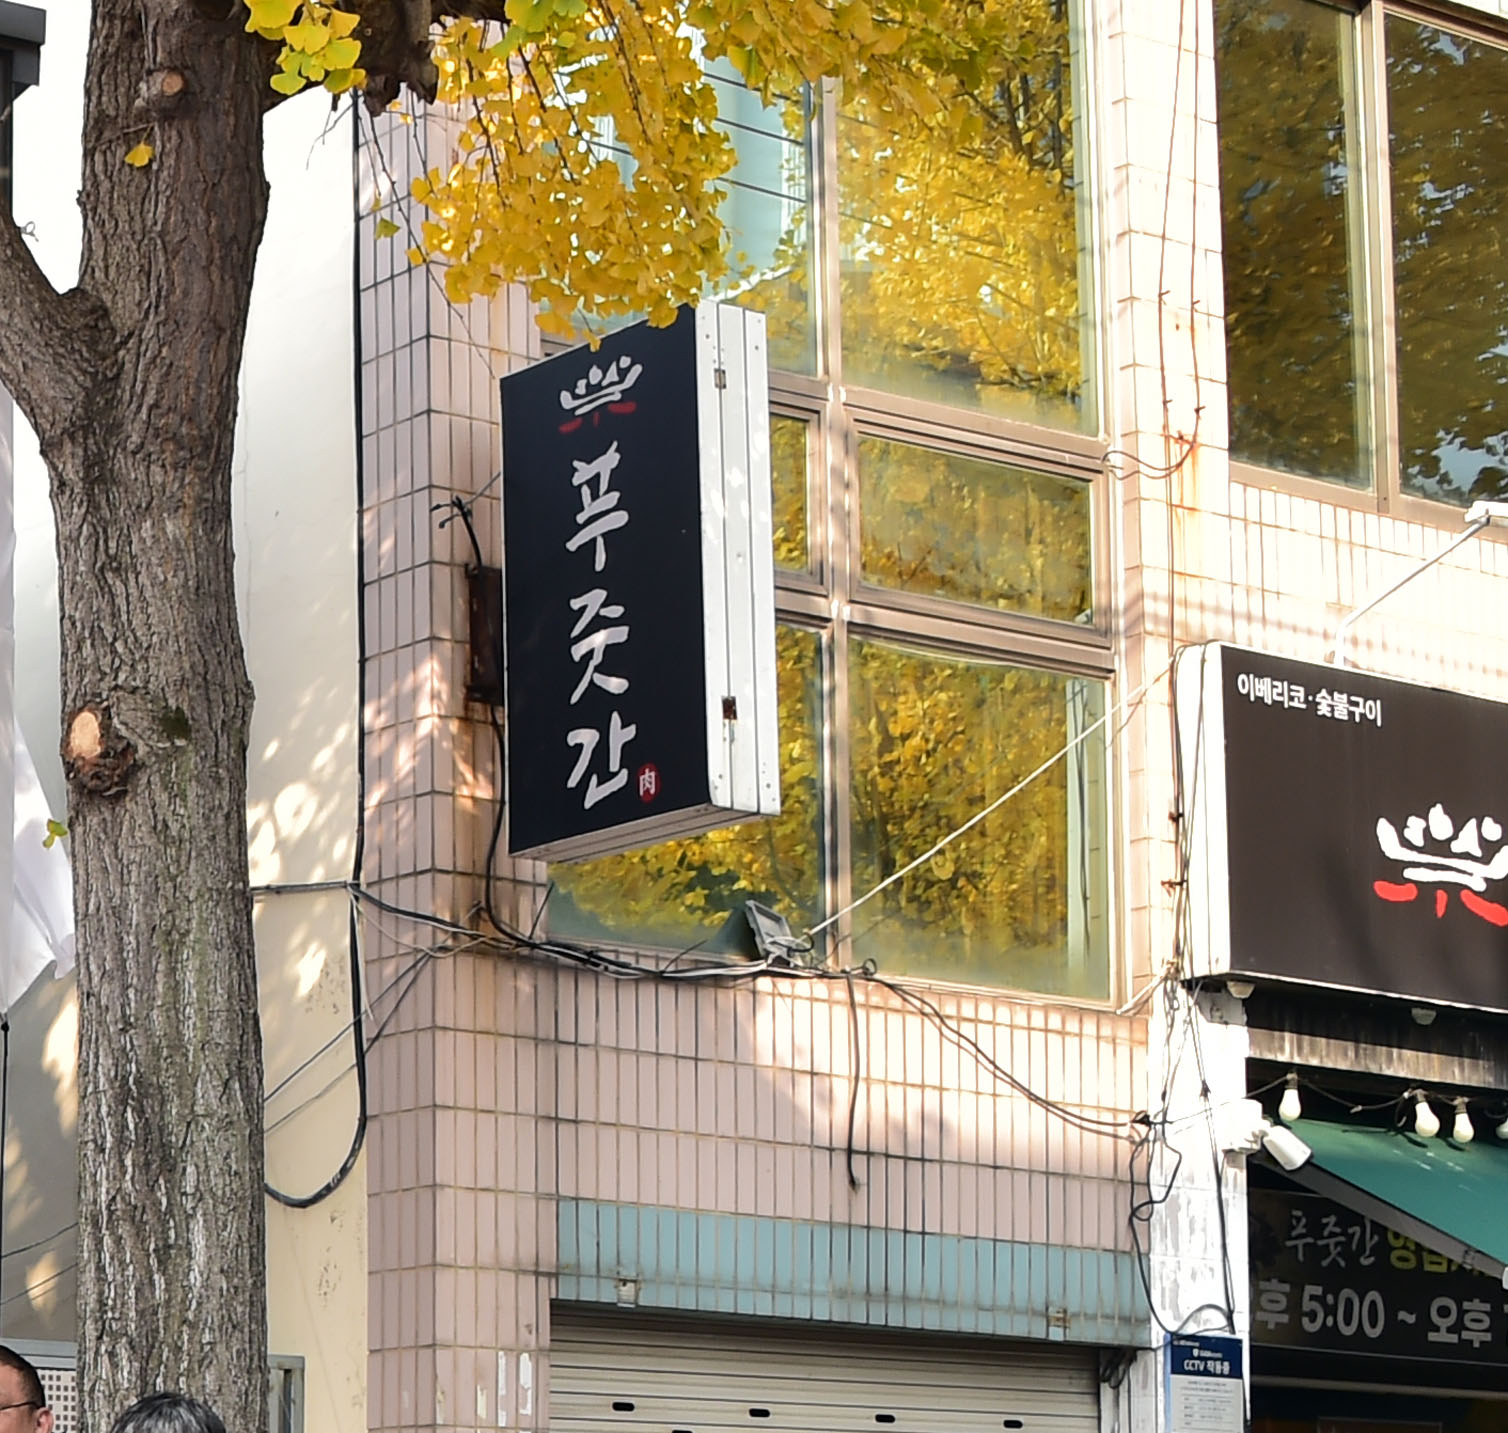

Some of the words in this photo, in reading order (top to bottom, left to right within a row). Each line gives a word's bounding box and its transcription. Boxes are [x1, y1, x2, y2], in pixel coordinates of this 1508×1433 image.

[566, 441, 636, 810] 푸줏간
[1237, 672, 1383, 728] 이베리코·숯불구이
[1285, 1208, 1379, 1269] 푸줏간
[1255, 1278, 1291, 1330] 후
[1301, 1284, 1386, 1339] 5:00
[1427, 1296, 1493, 1349] 오후
[1184, 1360, 1205, 1372] CCTV
